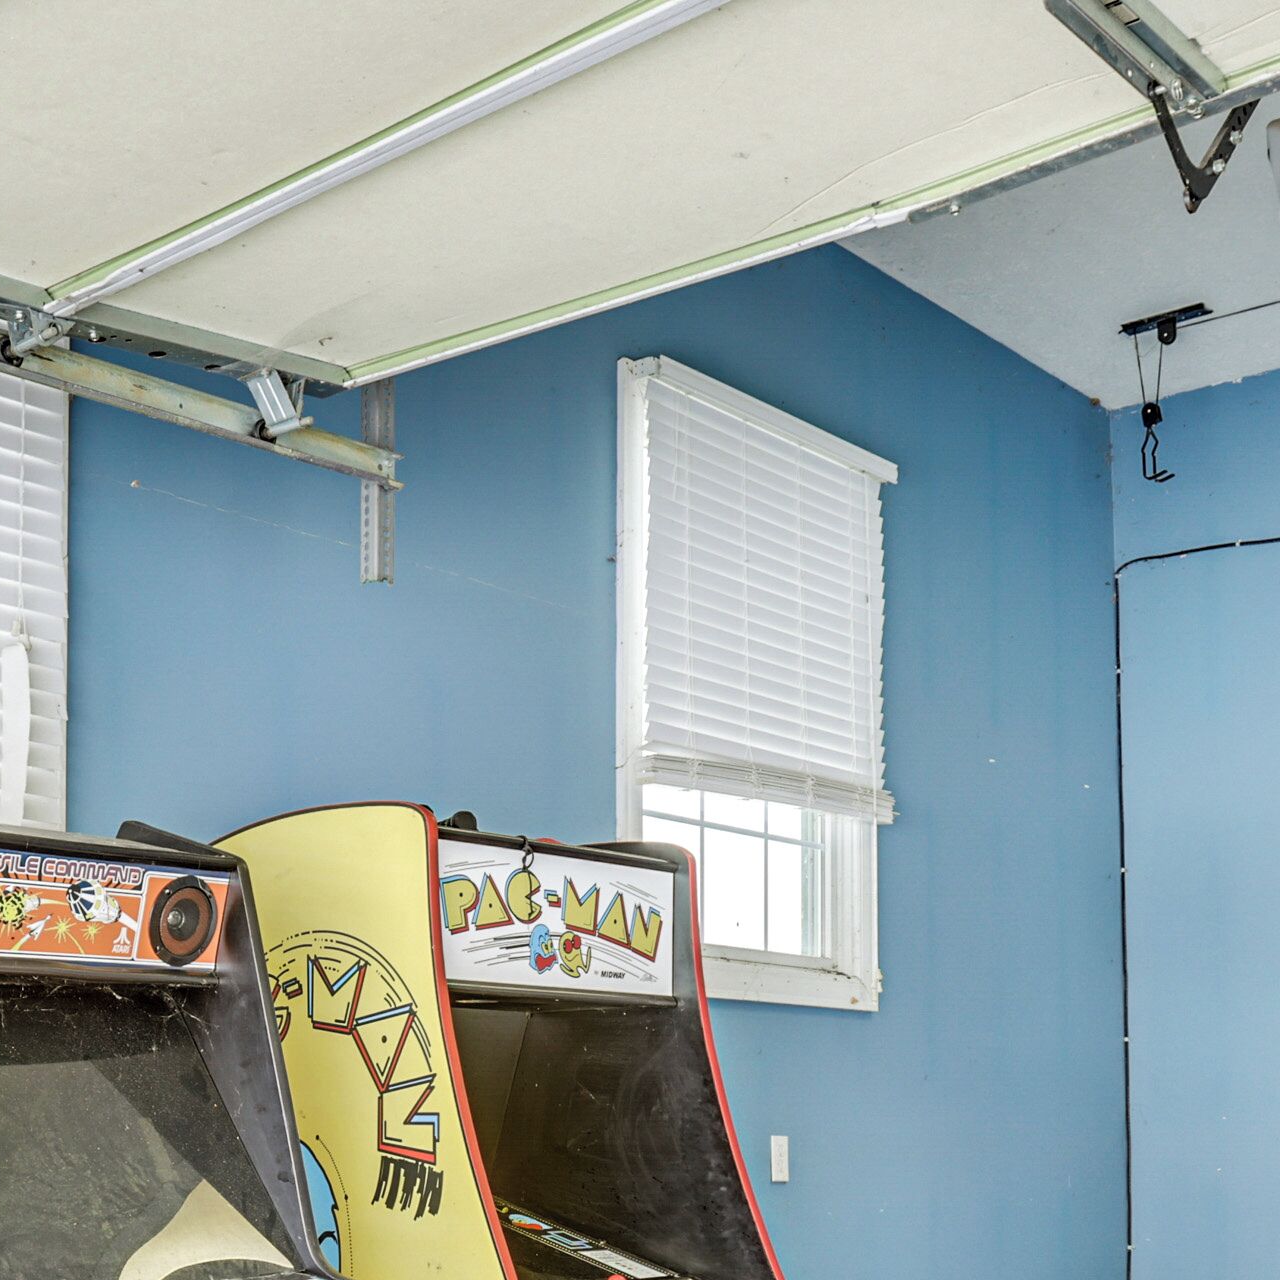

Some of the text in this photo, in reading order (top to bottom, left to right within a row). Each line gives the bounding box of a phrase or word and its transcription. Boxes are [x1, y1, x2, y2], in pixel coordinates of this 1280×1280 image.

[42, 857, 146, 886] COMMAND
[440, 869, 664, 963] PAC-MAN
[601, 970, 626, 979] MIDWAY
